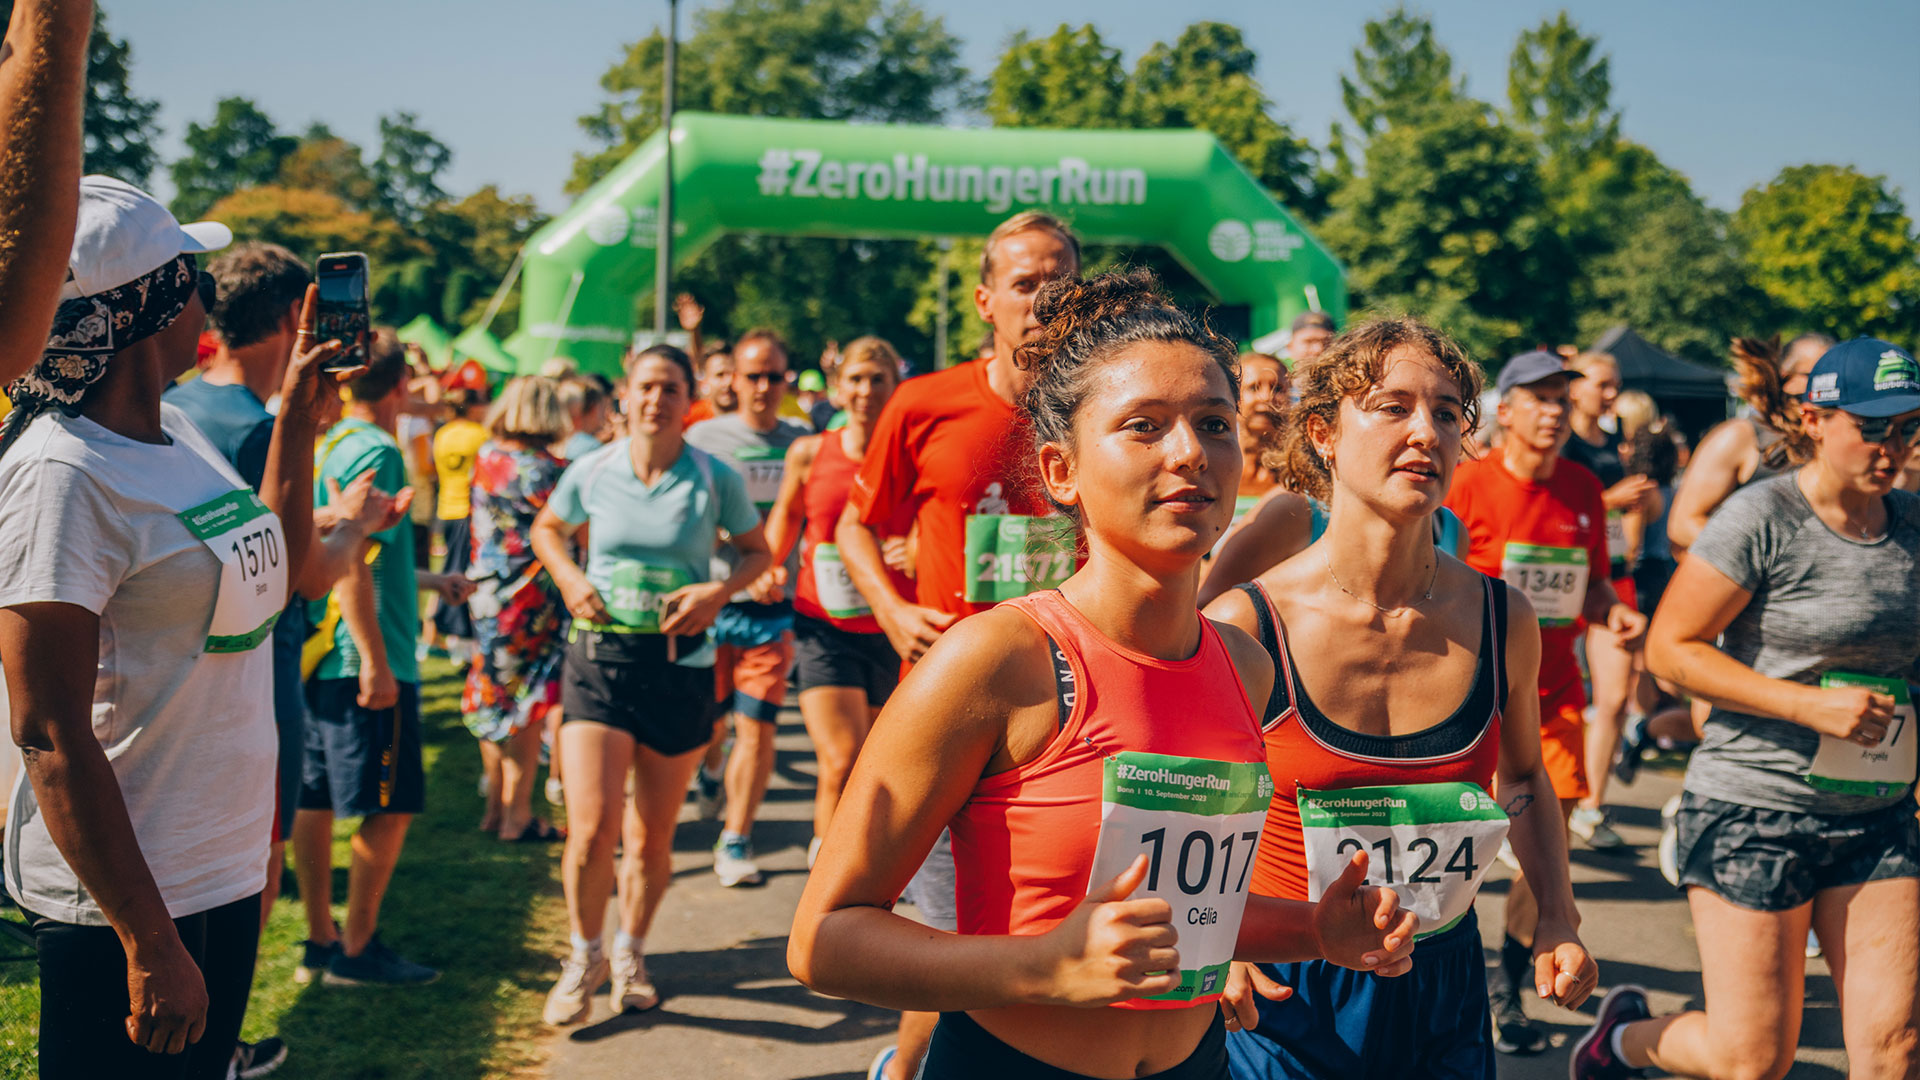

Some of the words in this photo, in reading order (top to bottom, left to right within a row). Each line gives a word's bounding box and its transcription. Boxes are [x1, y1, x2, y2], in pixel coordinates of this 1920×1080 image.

[757, 149, 1147, 213] #ZeroHungerRun
[232, 527, 279, 582] 1570
[977, 553, 1071, 583] 21572
[1519, 569, 1576, 594] 1348
[1116, 764, 1231, 791] #ZeroHungerRun
[1117, 786, 1135, 794] Bonn
[1144, 789, 1154, 797] 10.
[1156, 790, 1190, 800] September
[1191, 794, 1207, 802] 2023
[1307, 797, 1407, 809] #ZeroHungerRun
[1141, 827, 1259, 896] 1017
[1336, 837, 1479, 885] 2124
[1187, 907, 1217, 925] Célia
